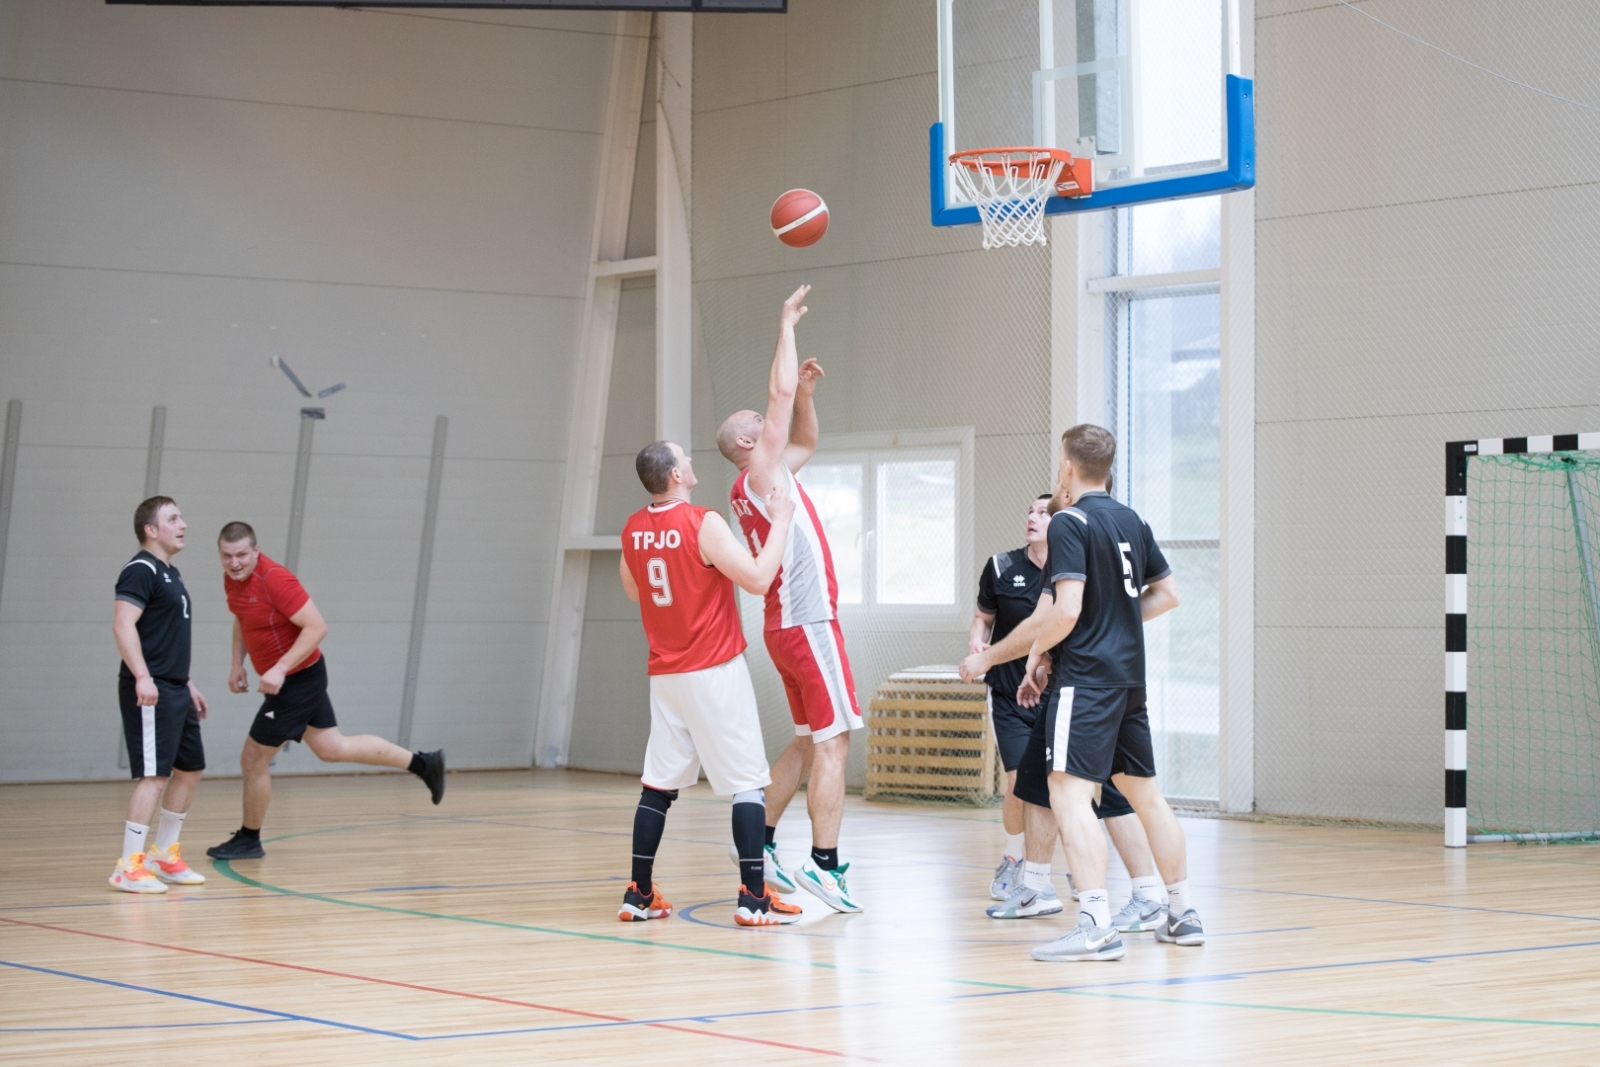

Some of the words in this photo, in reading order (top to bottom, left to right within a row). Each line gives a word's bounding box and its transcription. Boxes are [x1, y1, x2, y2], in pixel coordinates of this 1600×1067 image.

[631, 529, 682, 550] TPJO
[646, 557, 673, 607] 9
[1117, 542, 1139, 598] 5
